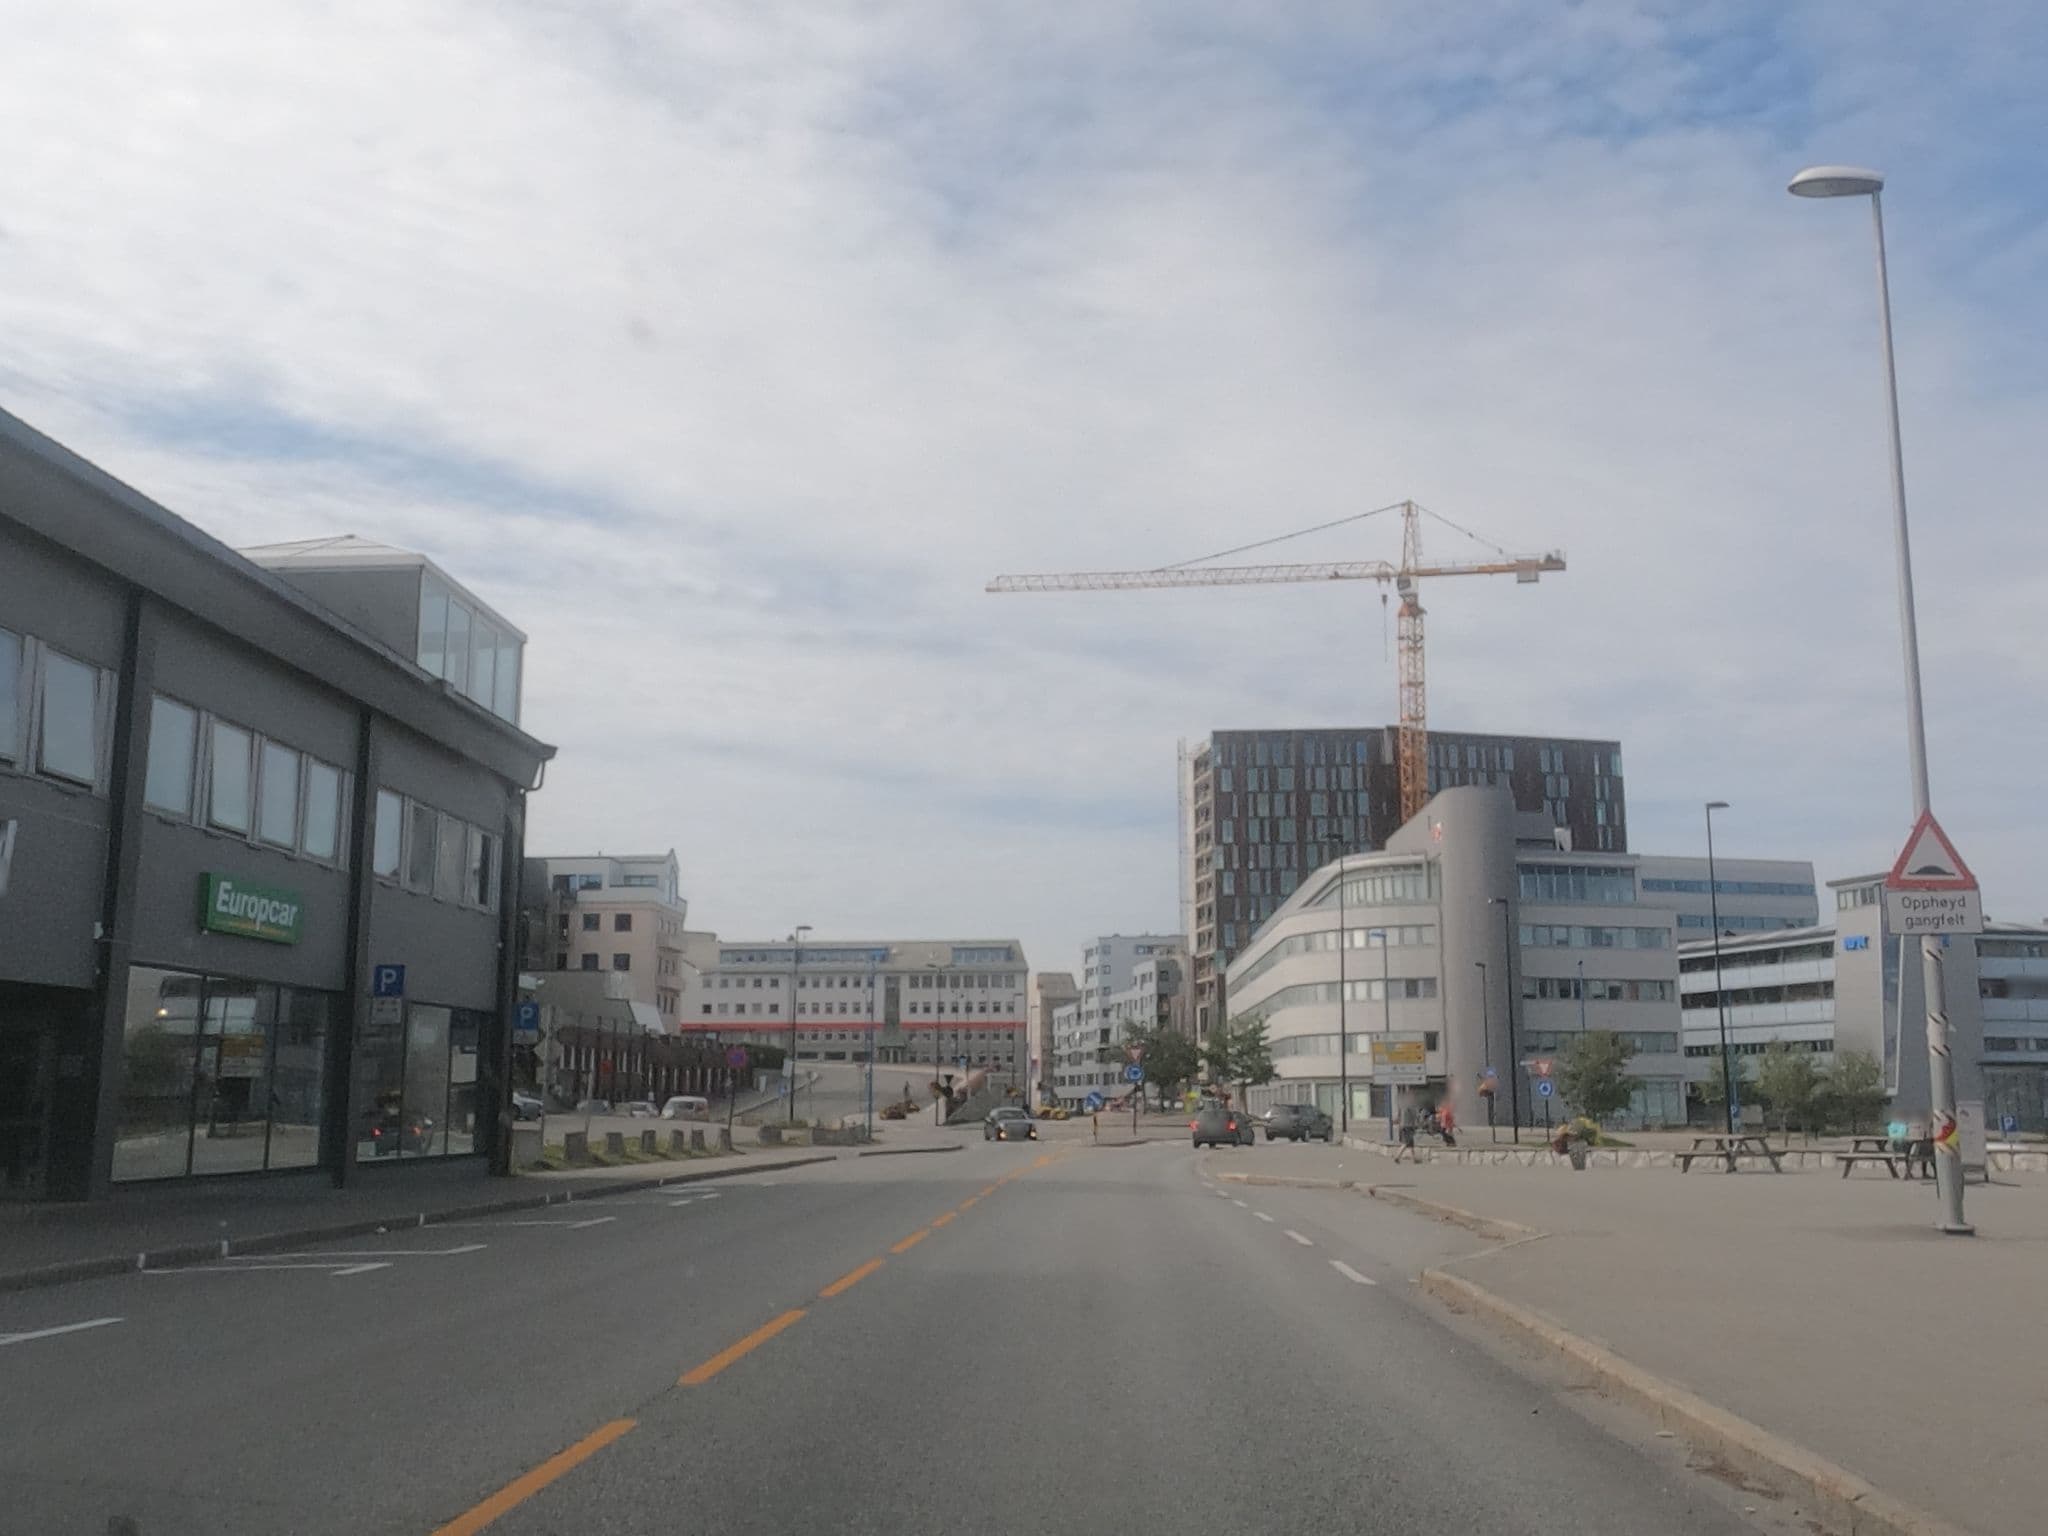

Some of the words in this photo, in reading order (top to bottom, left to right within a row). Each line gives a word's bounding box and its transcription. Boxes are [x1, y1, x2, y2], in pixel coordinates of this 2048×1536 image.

[216, 881, 298, 931] Europcar
[1902, 896, 1966, 911] Opphøyd
[1905, 914, 1964, 929] gangfelt
[382, 969, 397, 991] P
[520, 1006, 534, 1027] P
